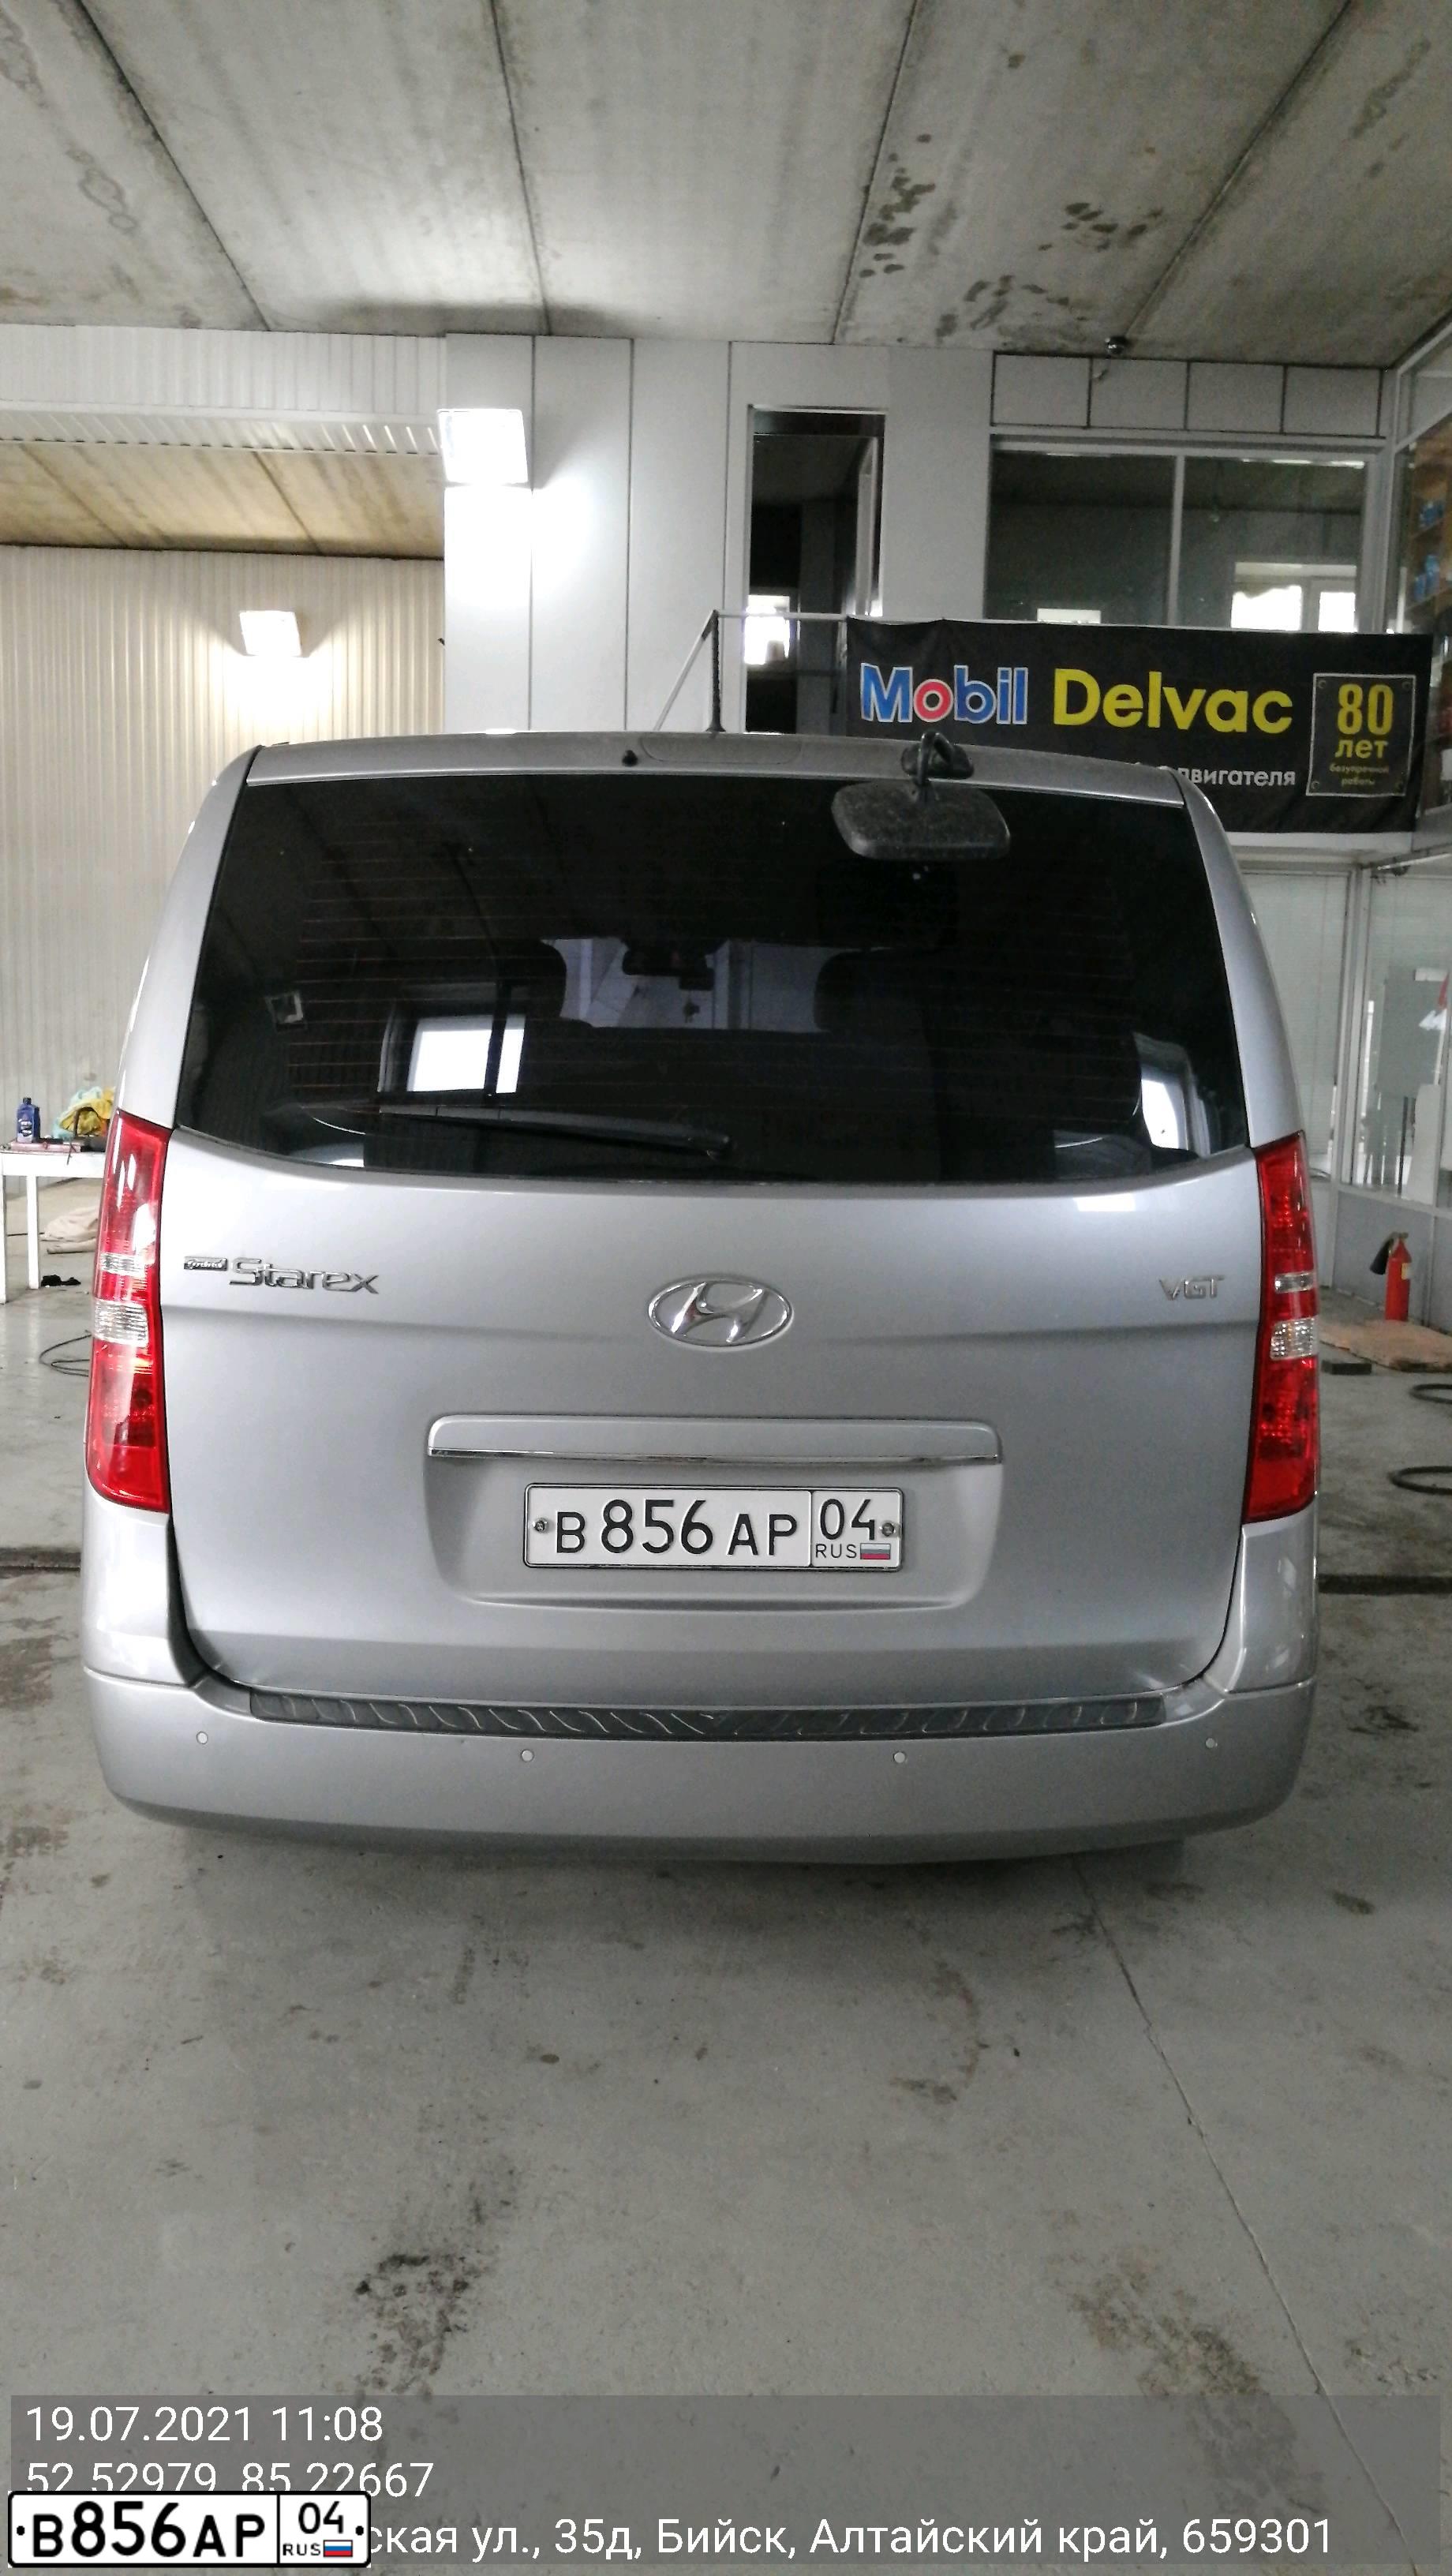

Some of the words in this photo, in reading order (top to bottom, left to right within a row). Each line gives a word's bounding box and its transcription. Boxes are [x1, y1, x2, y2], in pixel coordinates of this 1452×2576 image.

[860, 663, 1029, 726] Mobil
[1053, 668, 1293, 735] Delvac
[1337, 683, 1394, 736] 80
[1334, 739, 1389, 759] лет
[229, 1256, 379, 1295] Starex
[1159, 1274, 1225, 1301] VGT
[820, 1498, 876, 1541] 04
[815, 1543, 858, 1559] RUS
